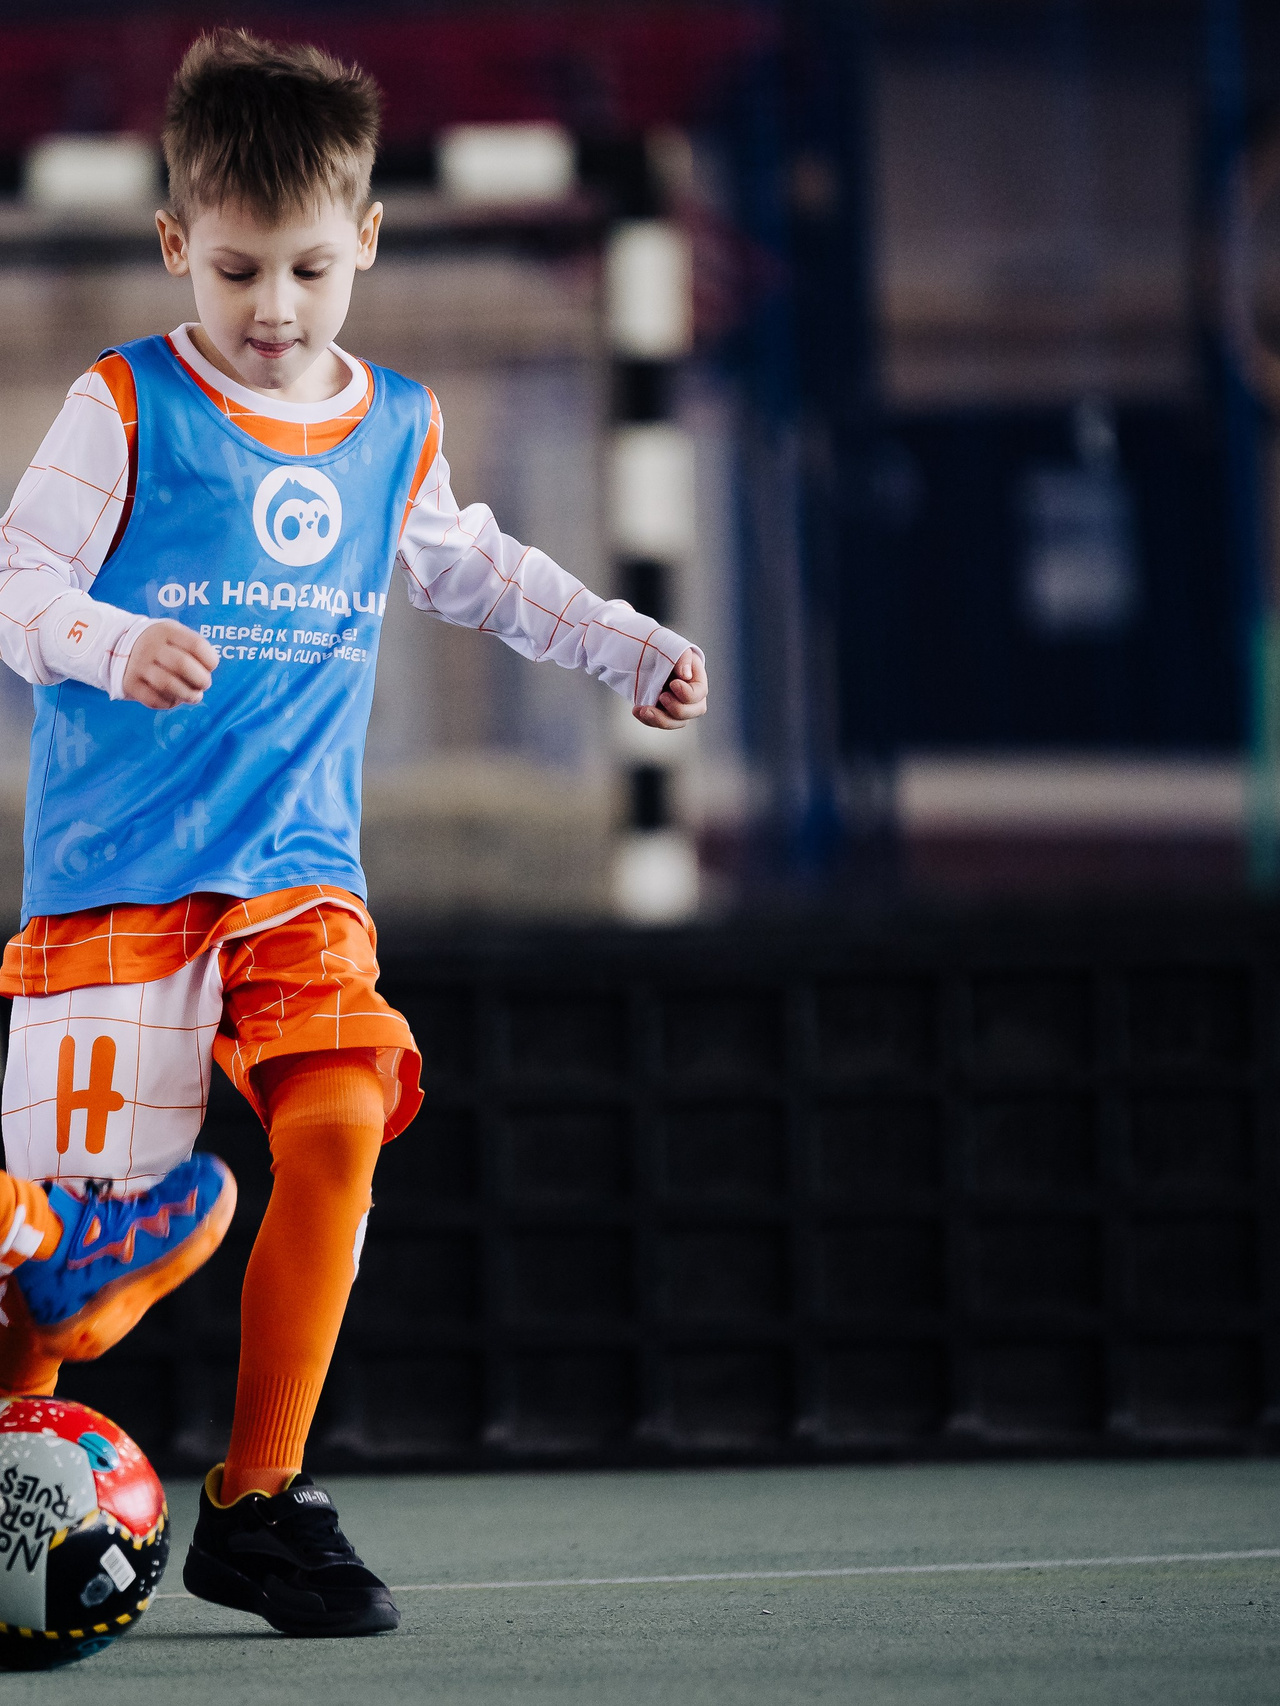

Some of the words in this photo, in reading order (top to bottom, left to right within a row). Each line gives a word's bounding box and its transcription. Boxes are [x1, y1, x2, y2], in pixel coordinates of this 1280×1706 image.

[157, 580, 210, 608] ФК
[67, 619, 89, 644] 31
[200, 624, 273, 644] ВПЕРЁД
[275, 628, 287, 643] К
[293, 628, 358, 648] ПОБЕДЕ!
[258, 647, 291, 662] МЫ
